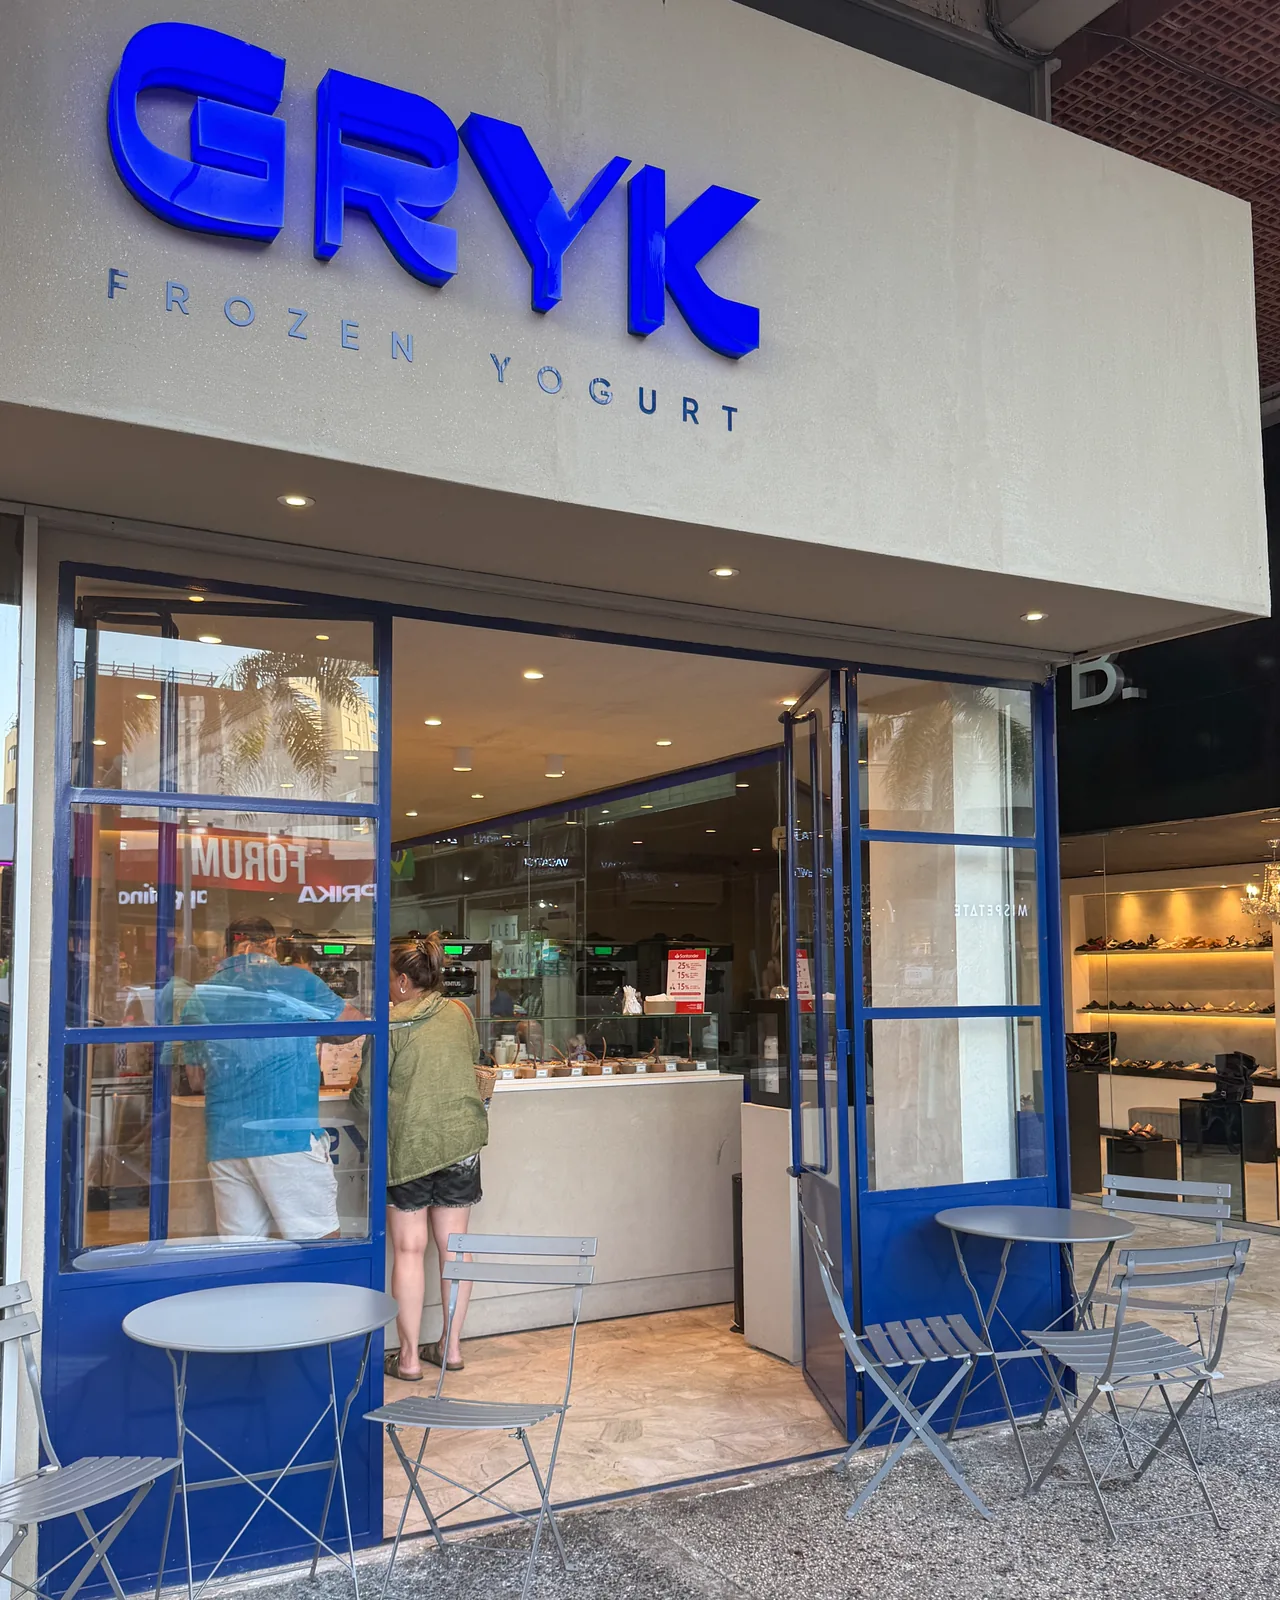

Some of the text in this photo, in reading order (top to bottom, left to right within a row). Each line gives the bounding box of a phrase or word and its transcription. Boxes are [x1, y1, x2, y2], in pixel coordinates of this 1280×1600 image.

[107, 22, 760, 360] GRYK
[107, 268, 739, 432] FROZEN YOGURT
